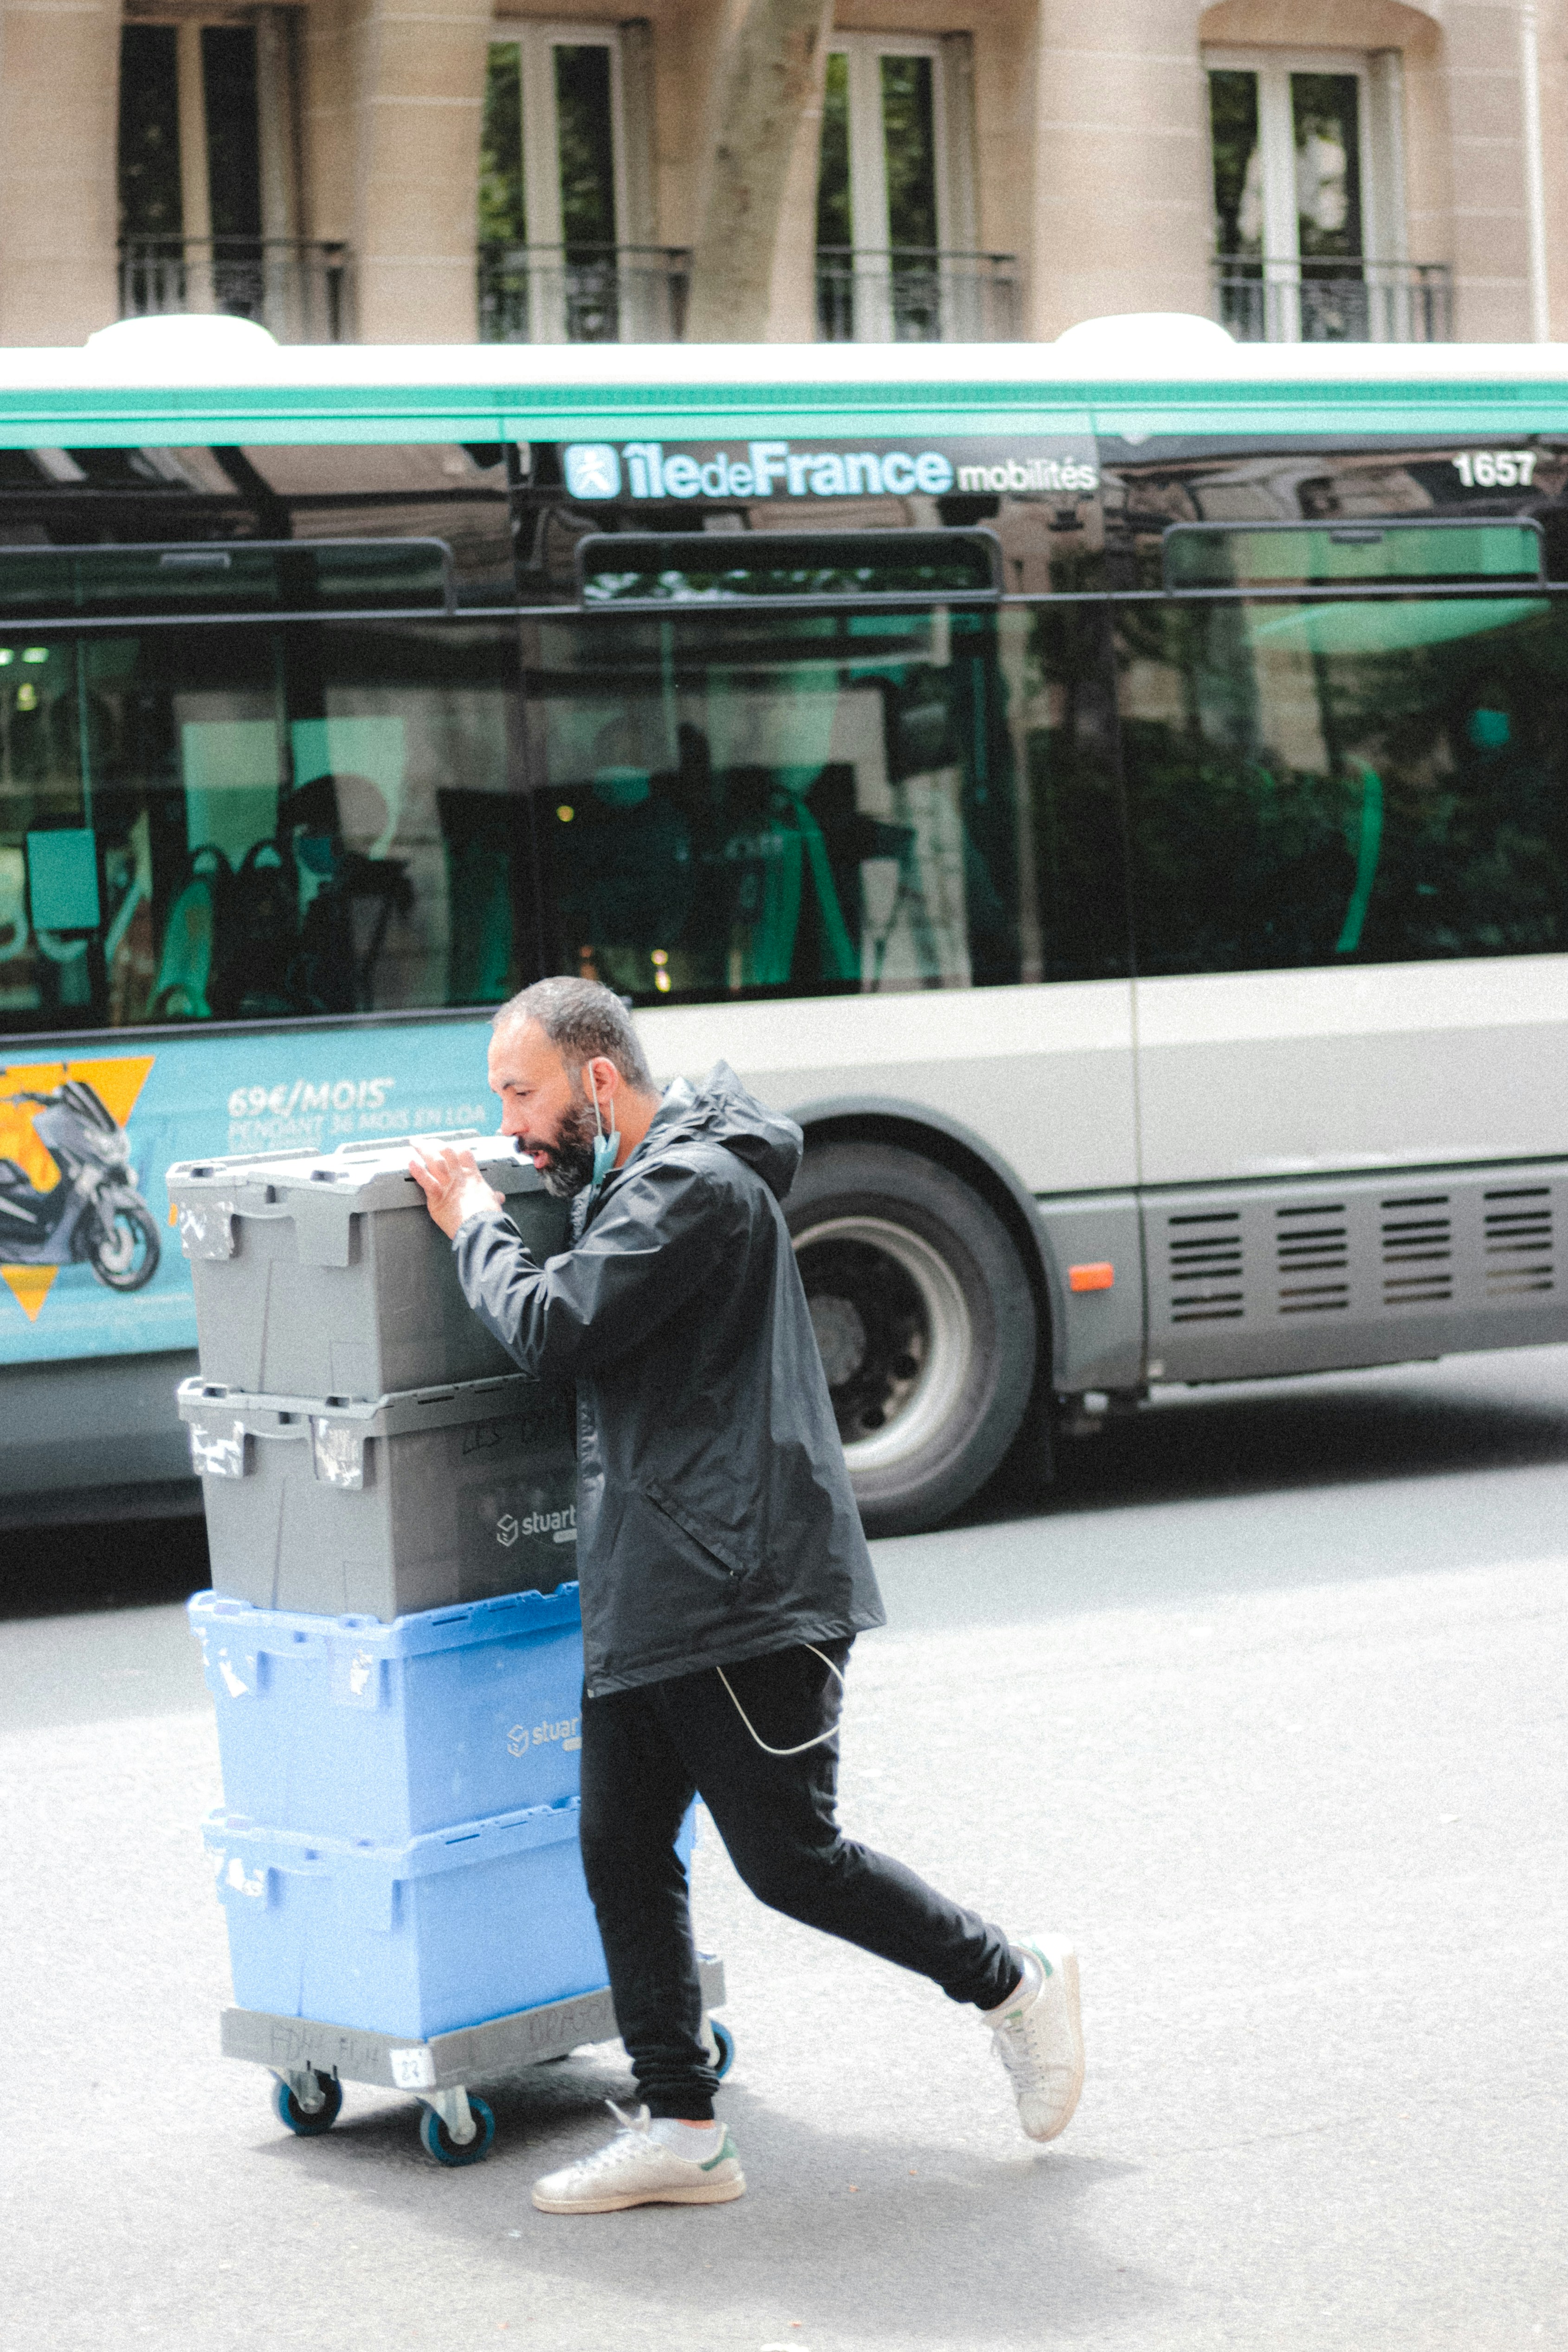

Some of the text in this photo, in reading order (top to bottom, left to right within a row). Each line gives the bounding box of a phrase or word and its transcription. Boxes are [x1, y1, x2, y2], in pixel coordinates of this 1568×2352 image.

[957, 455, 1099, 491] mobilités
[1452, 450, 1537, 487] 1657
[228, 1077, 395, 1117] 69€/MOIS
[521, 1504, 576, 1536] stuart
[532, 1712, 582, 1745] stuar
